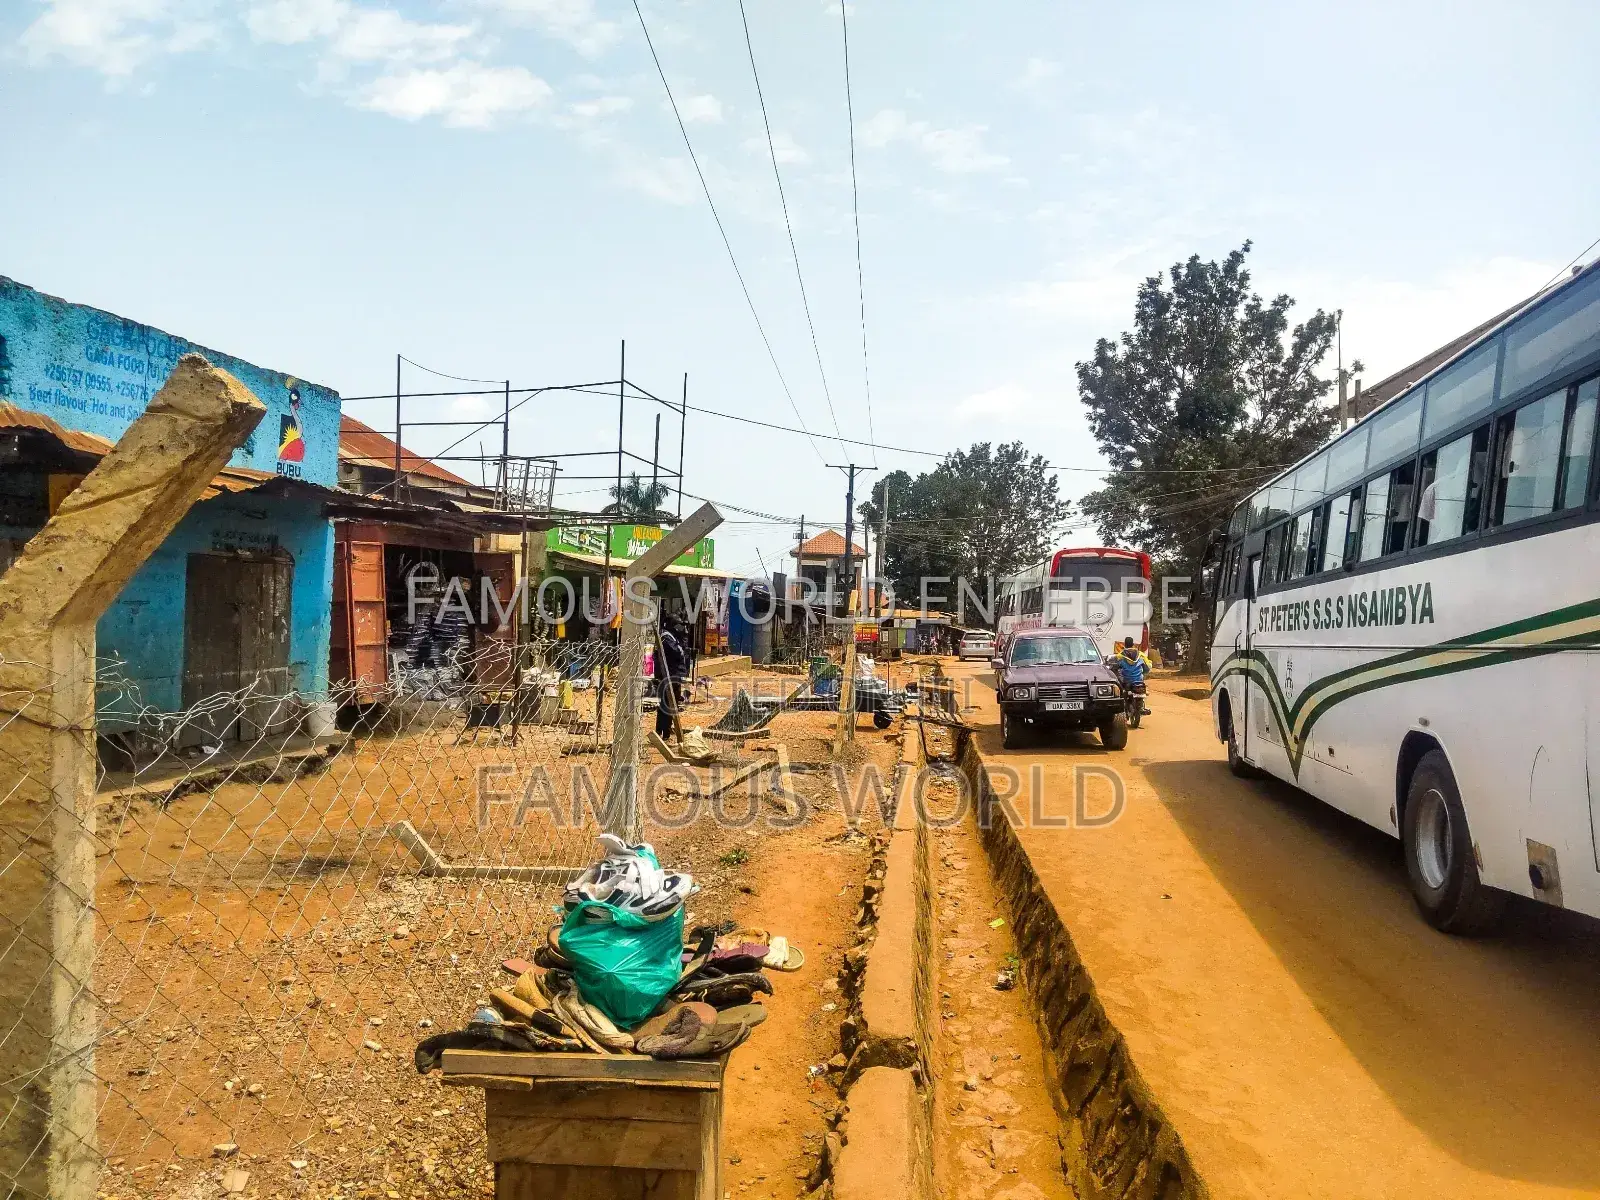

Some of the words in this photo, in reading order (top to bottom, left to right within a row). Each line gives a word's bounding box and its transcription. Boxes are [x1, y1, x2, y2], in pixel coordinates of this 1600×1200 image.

[117, 353, 145, 375] FOOD
[110, 404, 126, 419] and
[276, 462, 302, 477] BUBU
[1313, 596, 1344, 630] S.S.S
[1347, 582, 1435, 628] NSAMBYA
